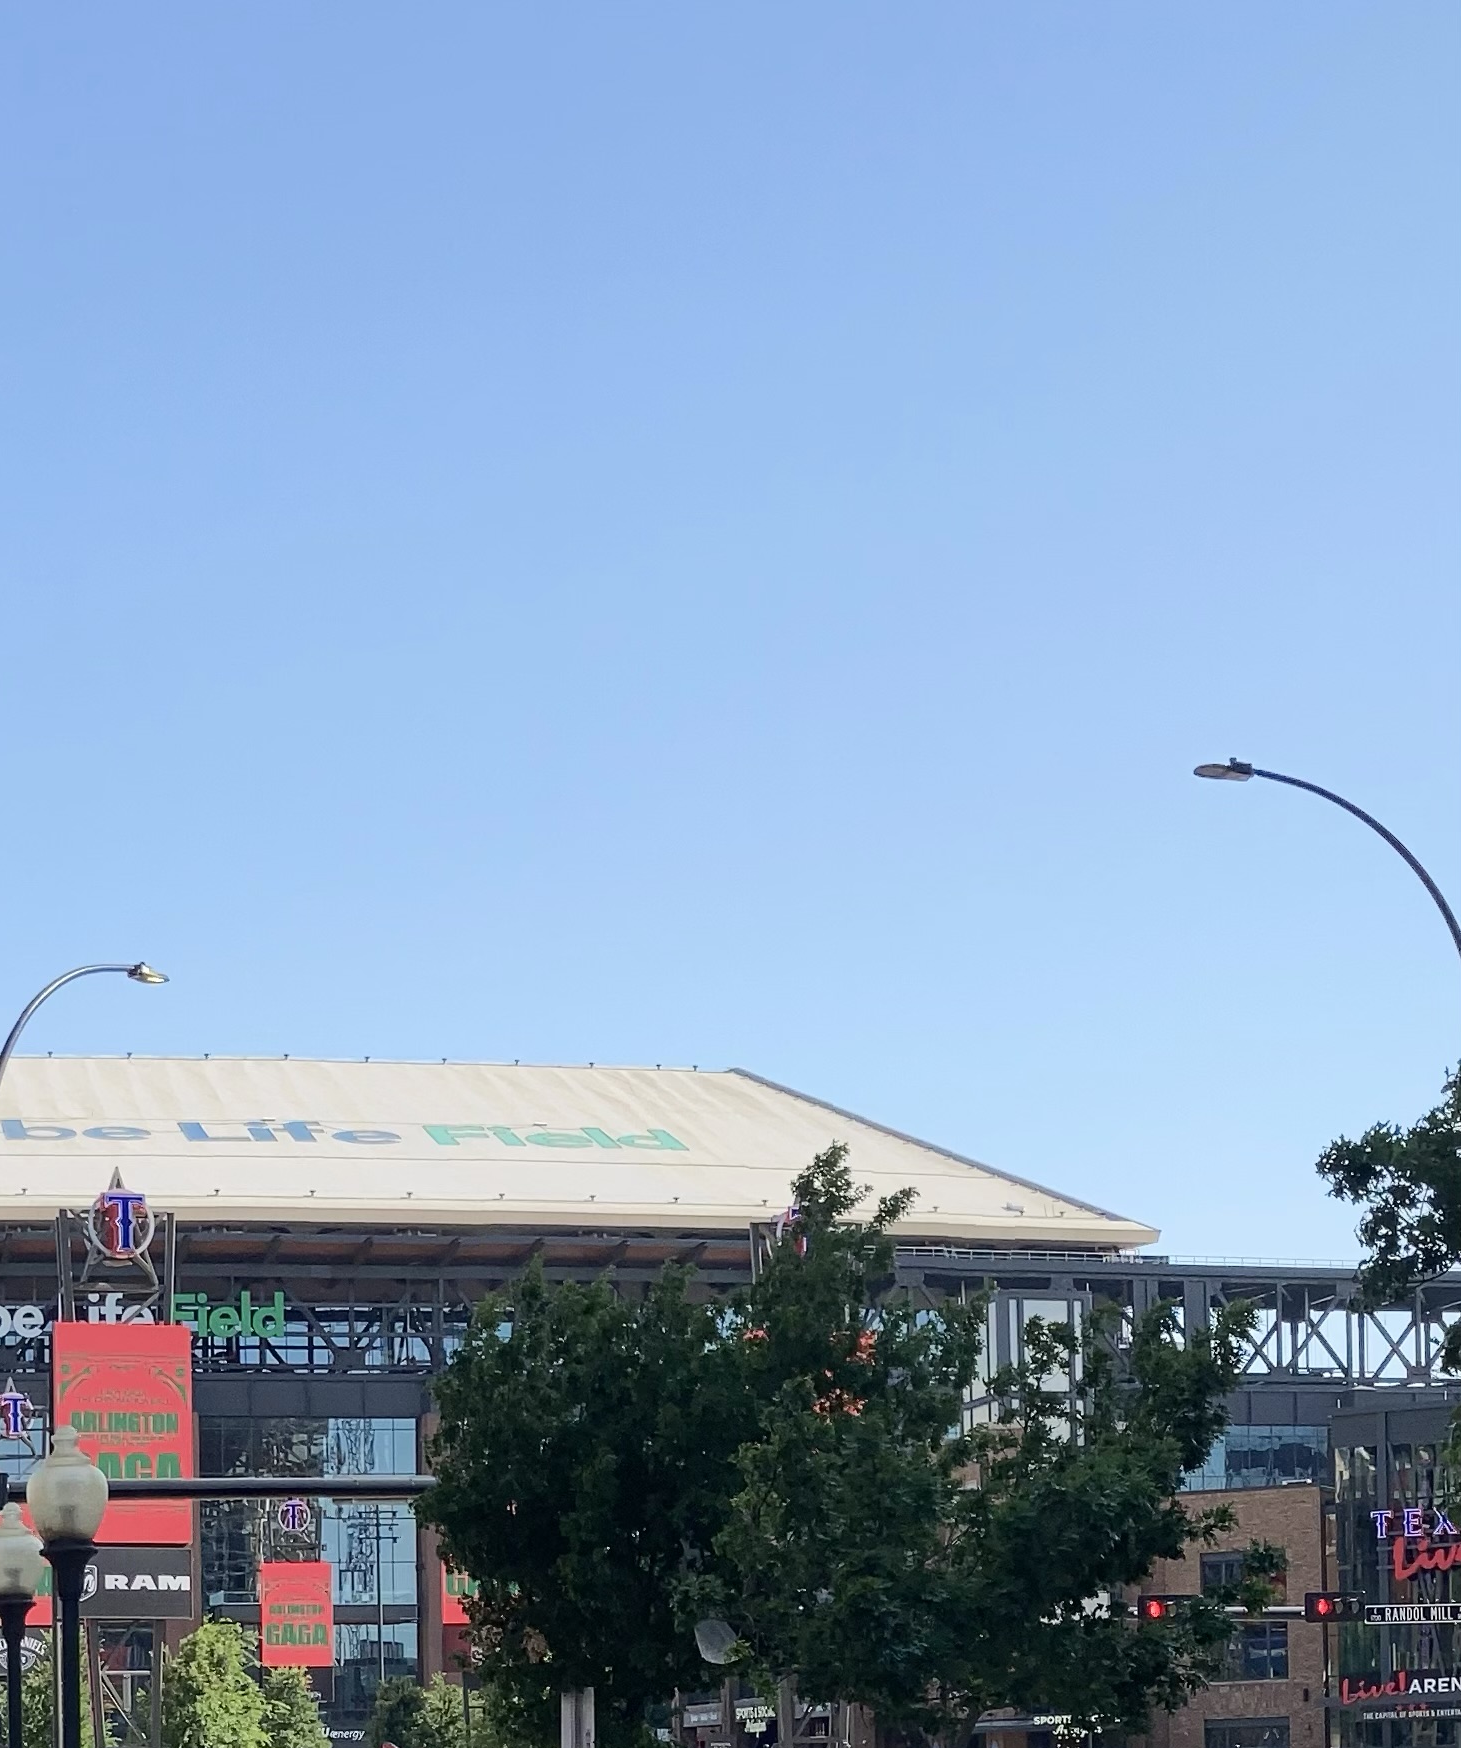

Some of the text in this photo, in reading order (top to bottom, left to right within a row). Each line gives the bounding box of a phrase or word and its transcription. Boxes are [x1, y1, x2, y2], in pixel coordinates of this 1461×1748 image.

[178, 1120, 402, 1145] Life
[422, 1124, 690, 1151] Field
[87, 1292, 154, 1325] ife
[172, 1290, 285, 1338] Field
[96, 1452, 182, 1479] AGA
[104, 1574, 191, 1591] RAM
[1385, 1607, 1426, 1621] RANDOL
[1430, 1606, 1454, 1620] MILL
[266, 1623, 328, 1645] GAGA
[21, 1636, 48, 1656] NIEL'S
[1342, 1671, 1407, 1705] Live!
[1375, 1711, 1398, 1719] CAPITAL
[1409, 1710, 1430, 1718] SPORTS
[321, 1726, 366, 1741] Uenergy
